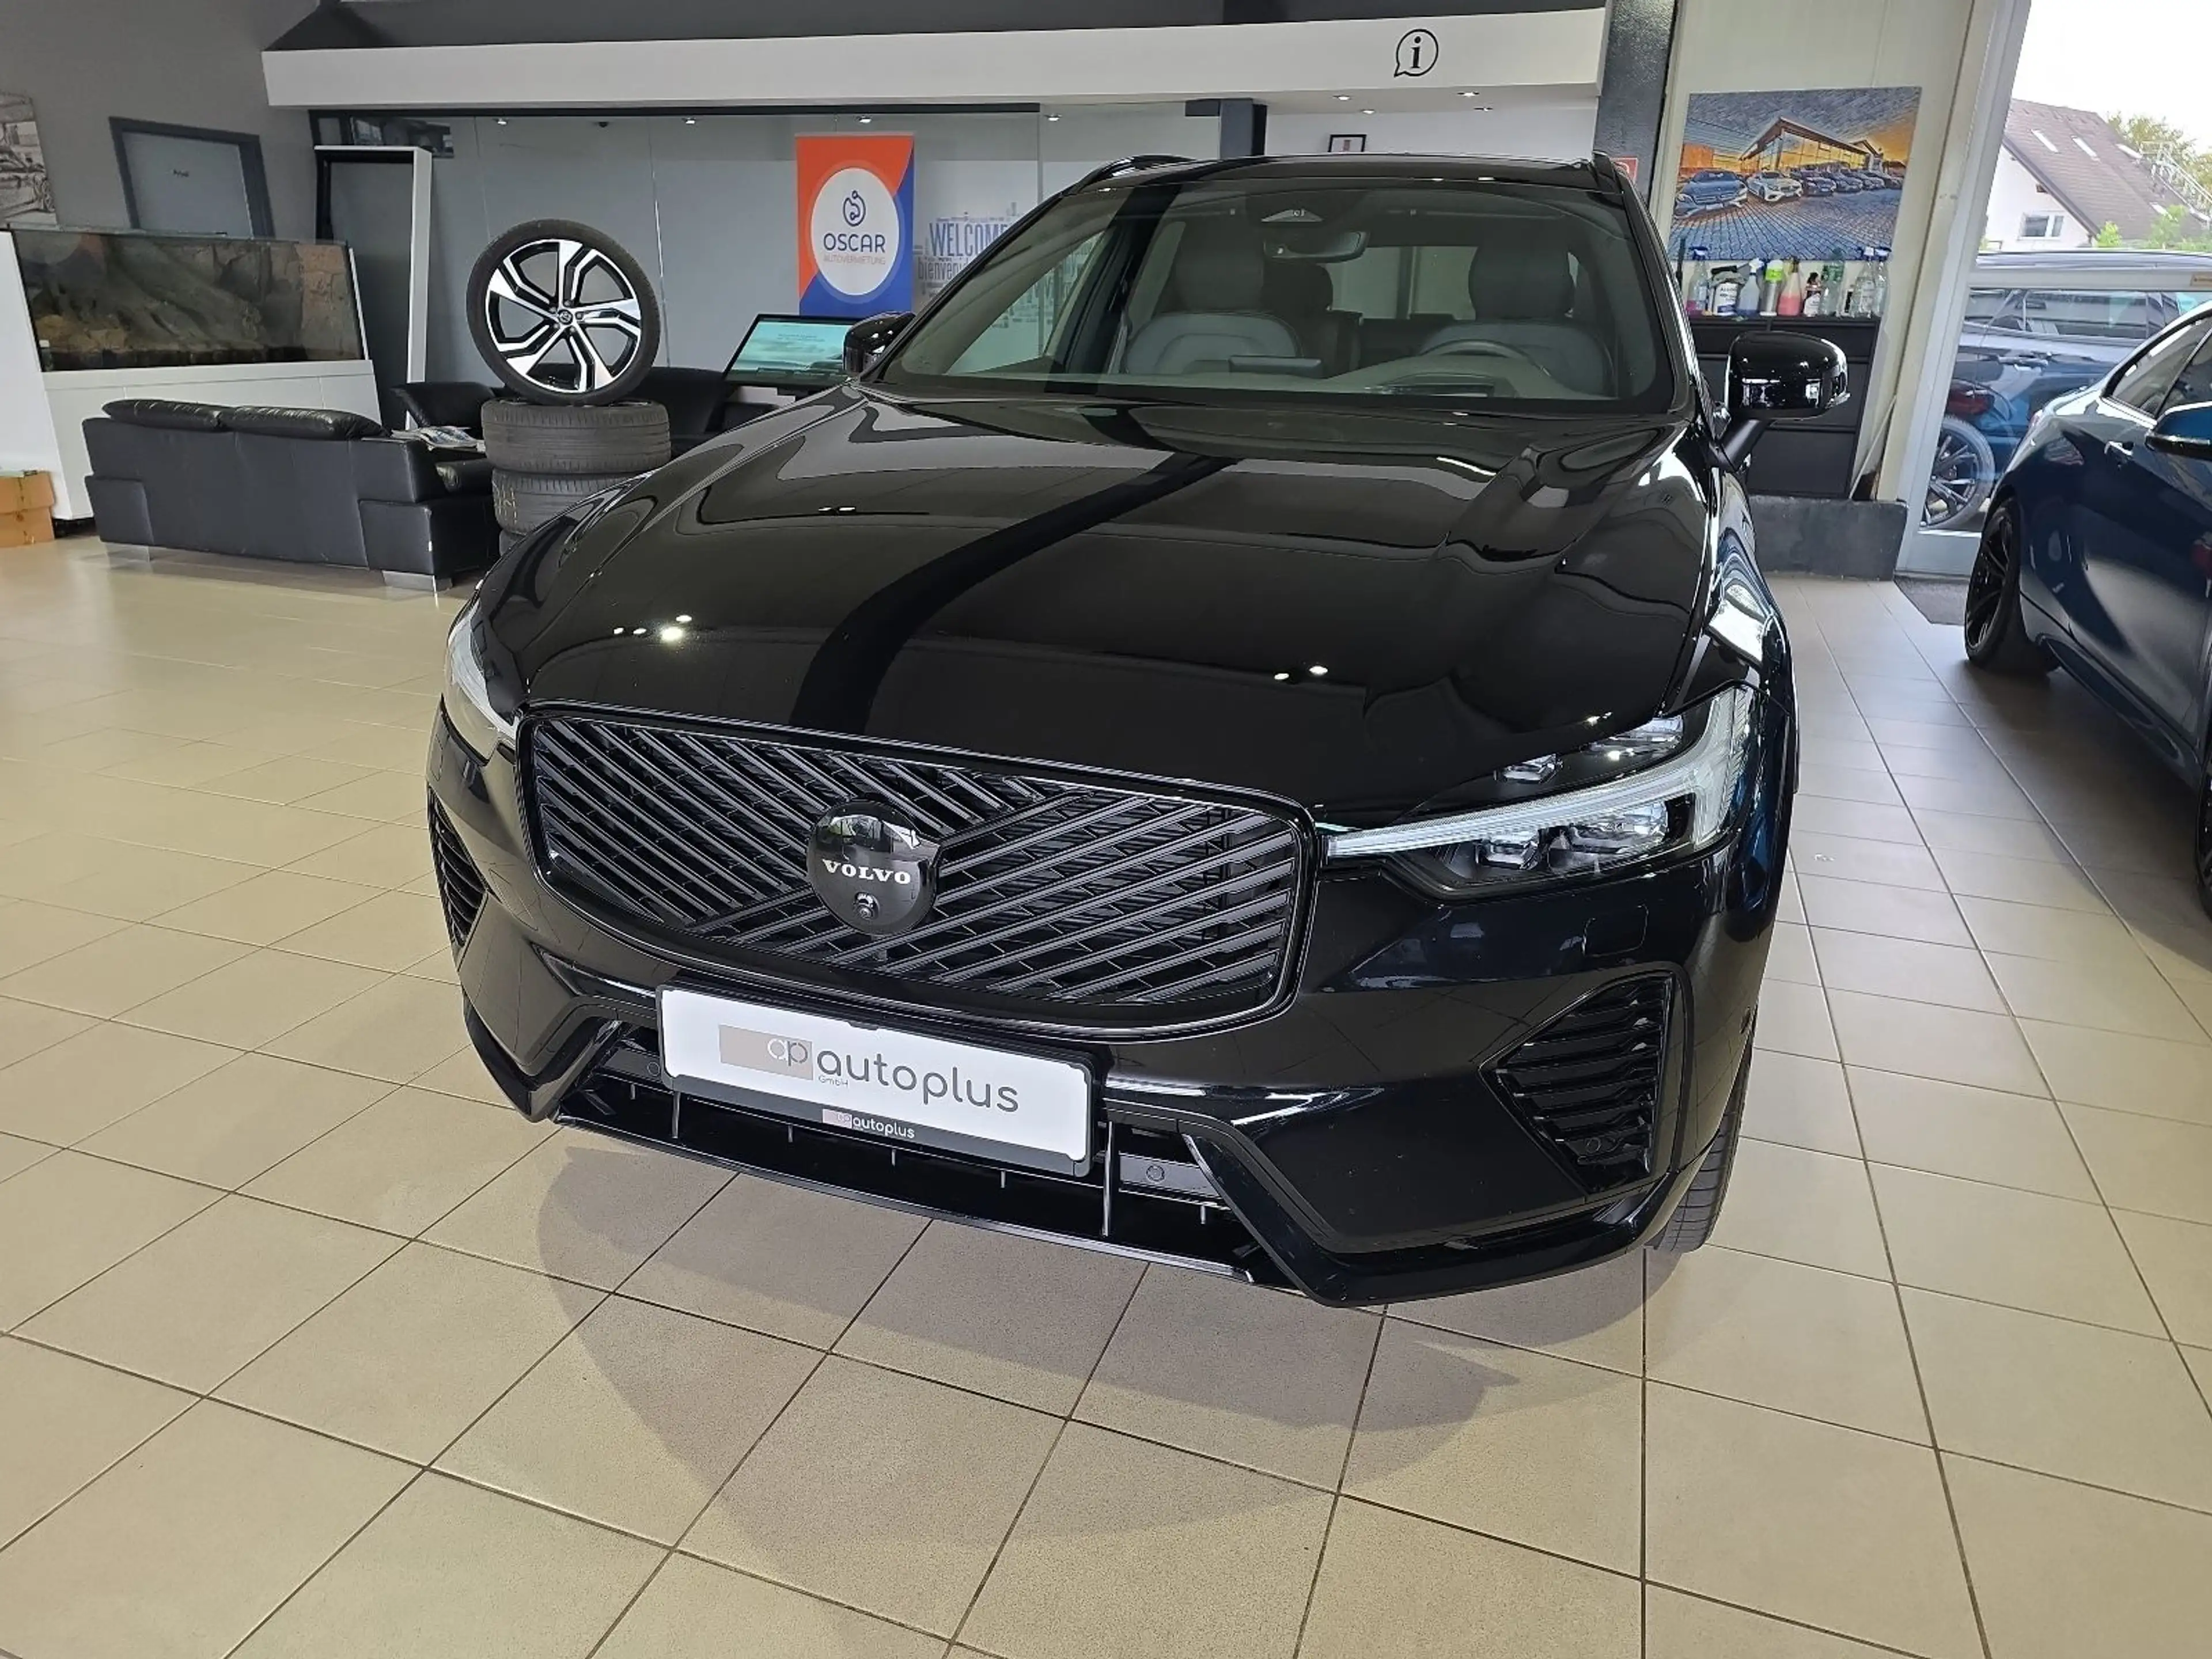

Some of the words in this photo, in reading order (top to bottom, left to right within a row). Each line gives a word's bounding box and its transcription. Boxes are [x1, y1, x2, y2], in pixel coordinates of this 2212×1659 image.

[823, 232, 886, 253] OSCAR
[929, 223, 1007, 256] WELCOM
[822, 859, 911, 884] VOLVO
[817, 1050, 1019, 1113] autoplus
[819, 1074, 849, 1088] GmbH
[853, 1116, 915, 1139] autoplus
